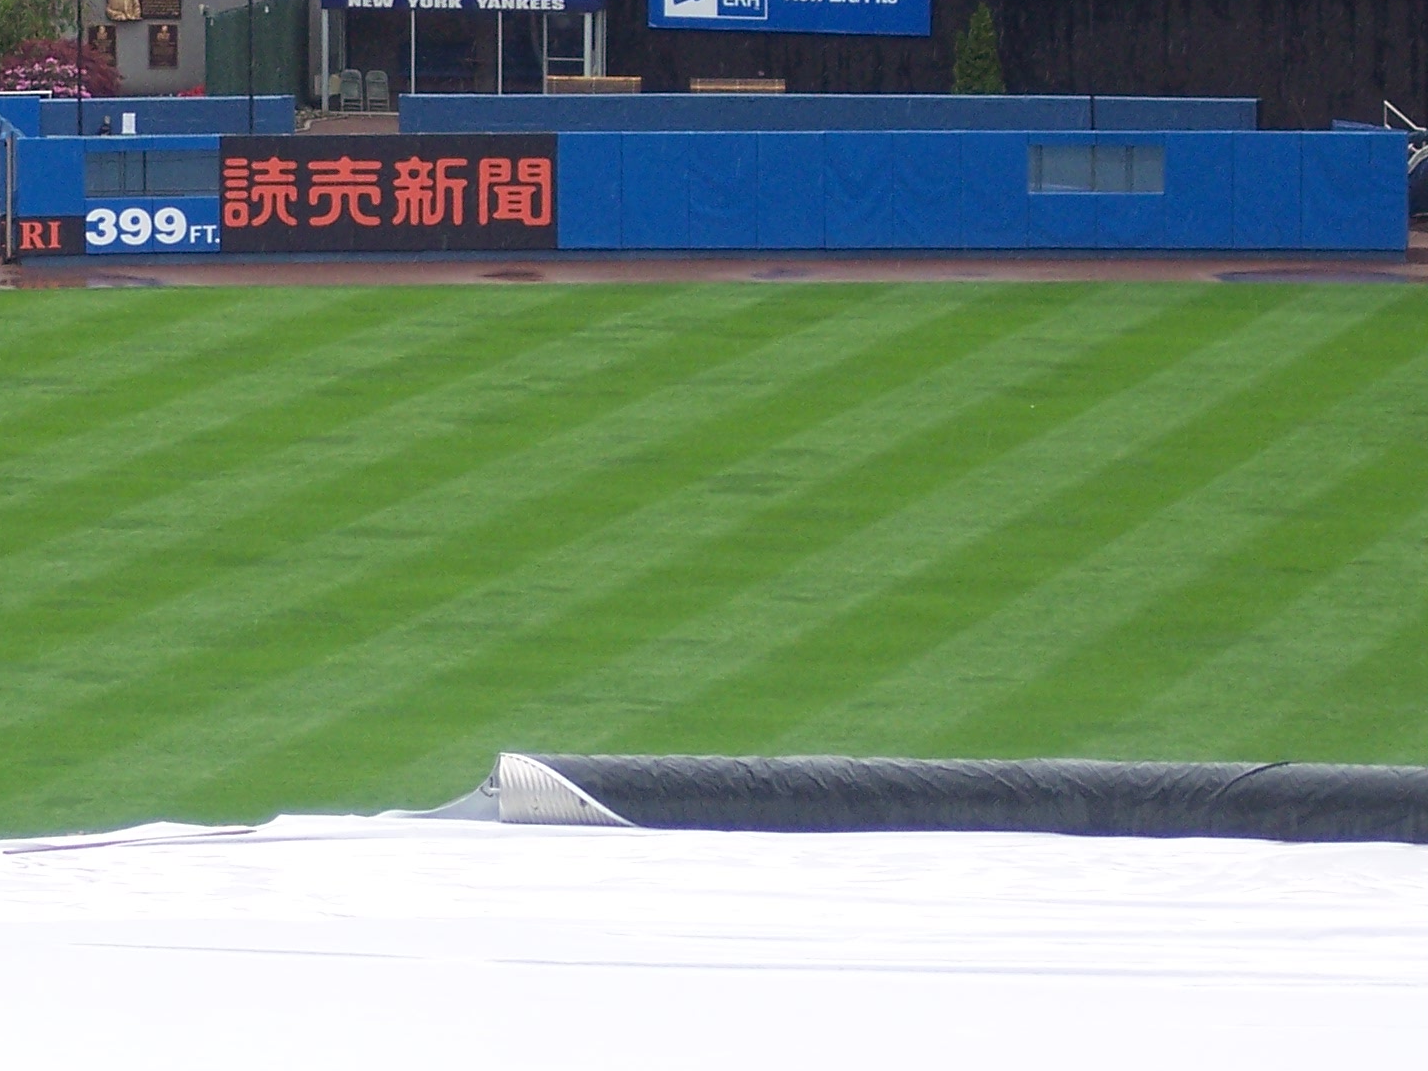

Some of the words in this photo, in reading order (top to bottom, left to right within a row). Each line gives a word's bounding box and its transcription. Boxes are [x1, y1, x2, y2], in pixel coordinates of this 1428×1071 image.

[224, 156, 552, 227] 読売新聞
[85, 207, 187, 246] 399
[190, 224, 221, 244] FT.
